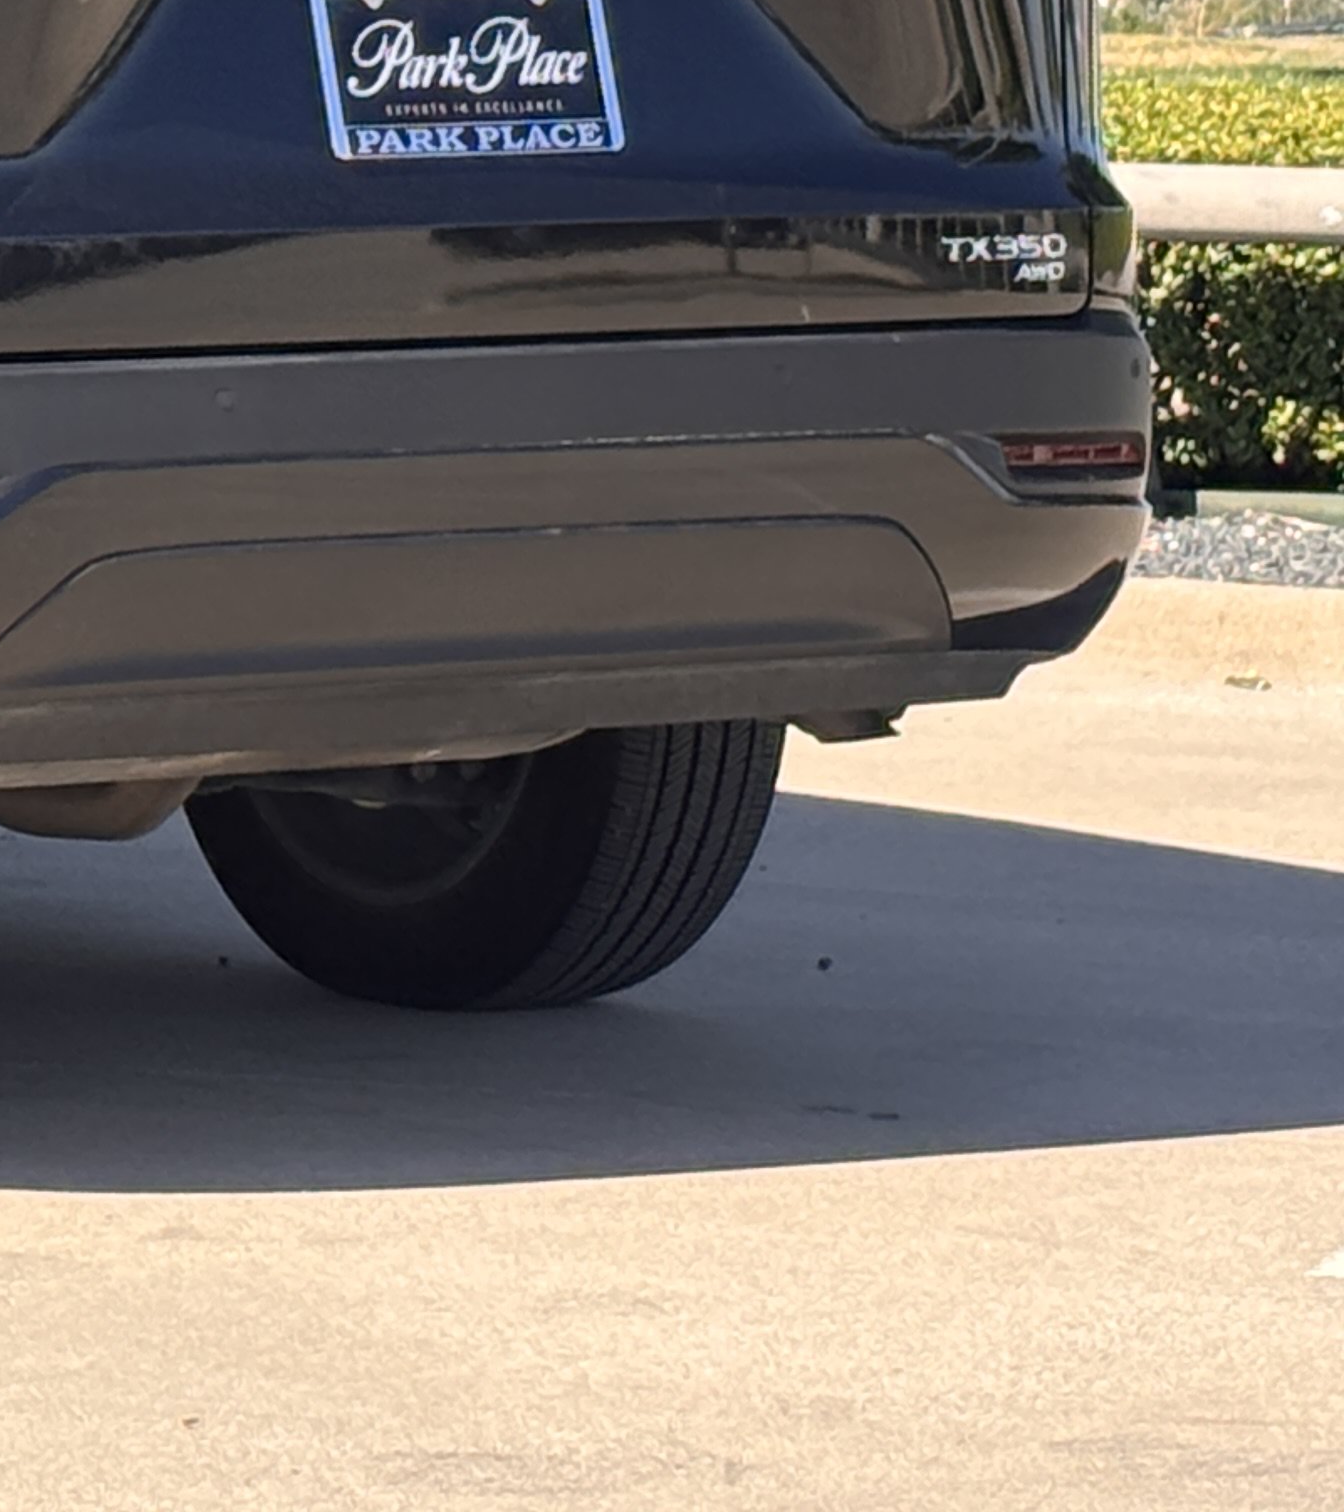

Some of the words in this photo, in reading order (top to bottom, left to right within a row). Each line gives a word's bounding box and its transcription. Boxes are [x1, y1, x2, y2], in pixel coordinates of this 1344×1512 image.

[346, 18, 469, 98] Park
[464, 16, 589, 94] Place
[355, 126, 468, 155] PARK
[474, 122, 605, 152] PLACE
[1013, 261, 1065, 283] AWD
